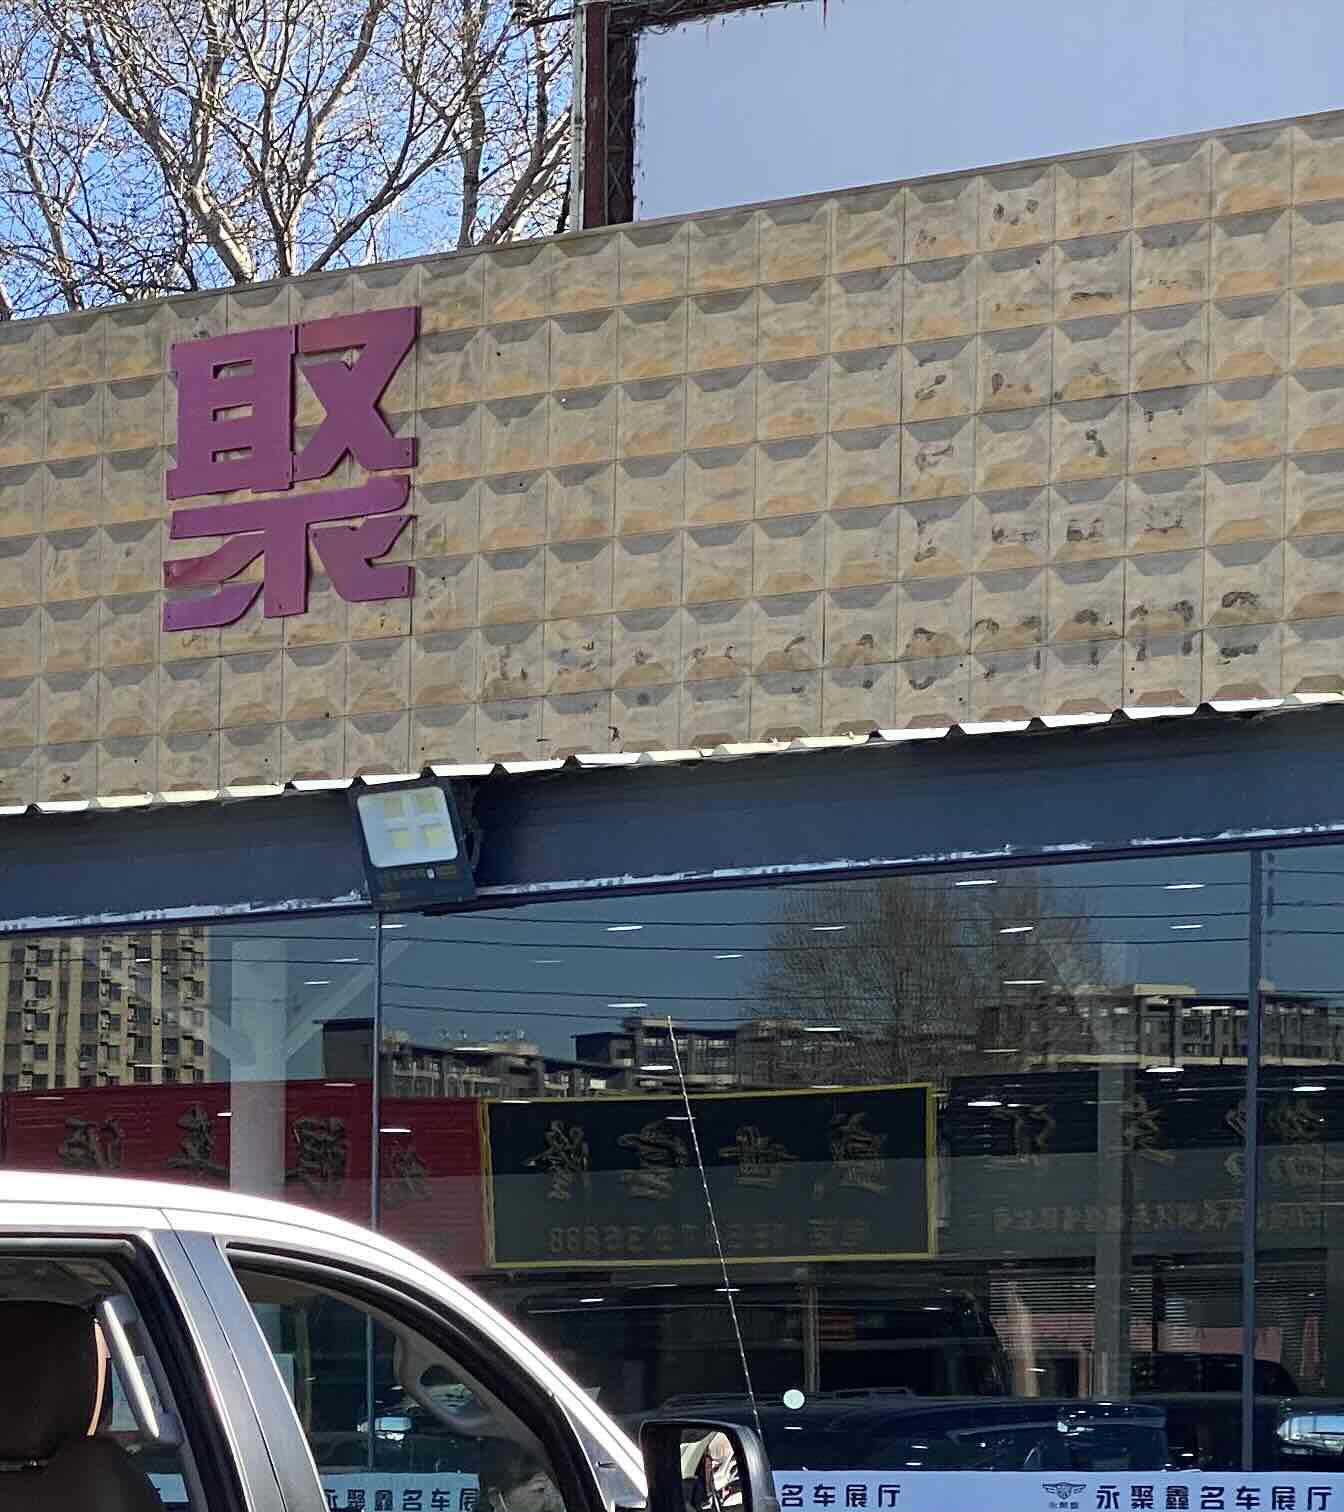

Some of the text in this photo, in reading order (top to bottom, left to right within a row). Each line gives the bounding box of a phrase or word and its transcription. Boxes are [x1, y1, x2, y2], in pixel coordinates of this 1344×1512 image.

[163, 306, 419, 631] 聚
[1096, 1484, 1332, 1512] 永聚鑫名车展厅
